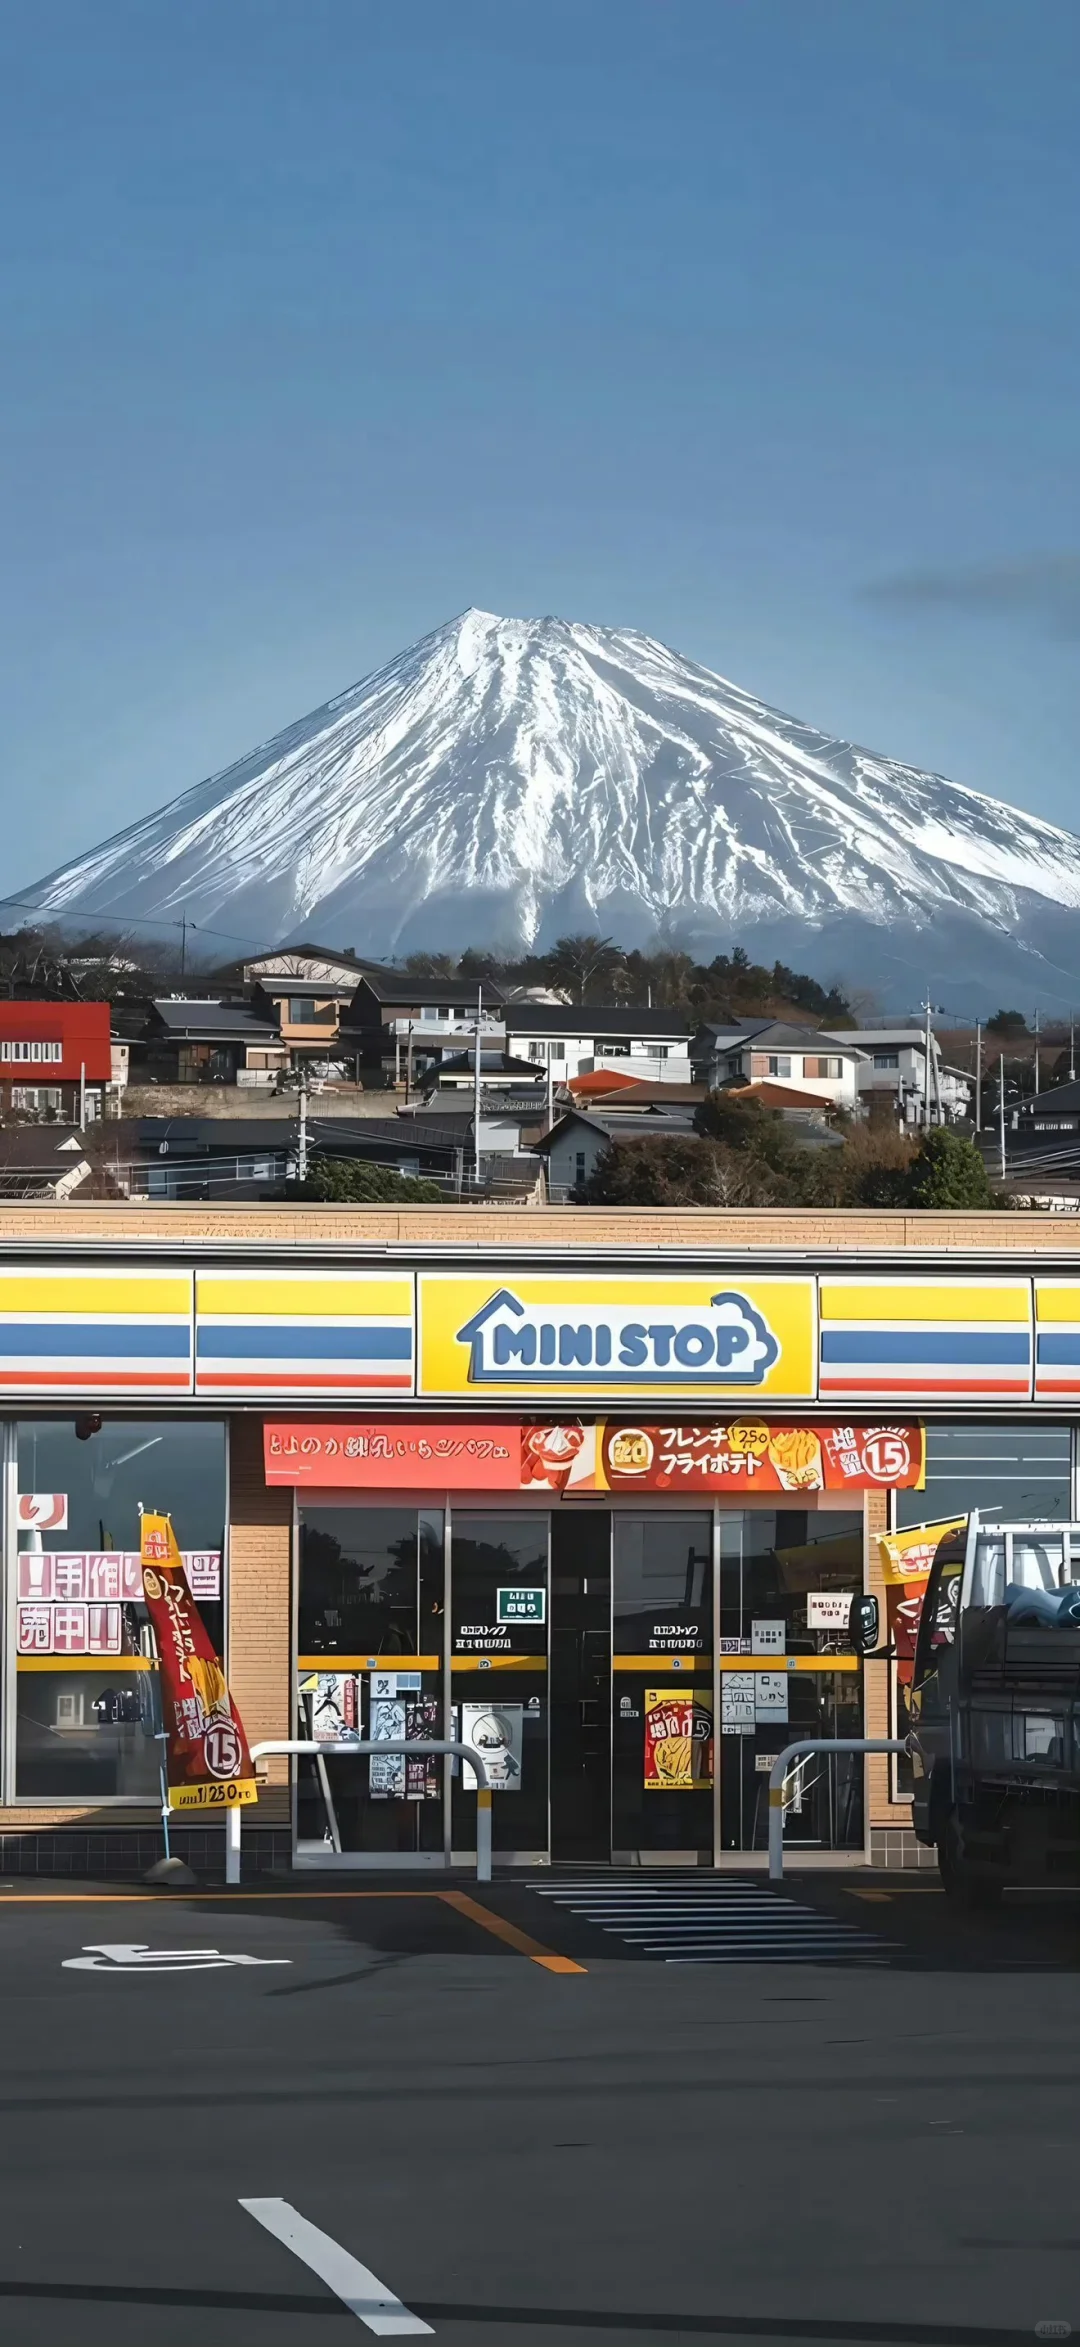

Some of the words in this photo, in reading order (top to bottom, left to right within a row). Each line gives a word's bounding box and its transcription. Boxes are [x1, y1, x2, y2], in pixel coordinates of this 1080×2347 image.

[659, 1427, 728, 1448] フレンチ
[659, 1452, 763, 1475] フライポテト
